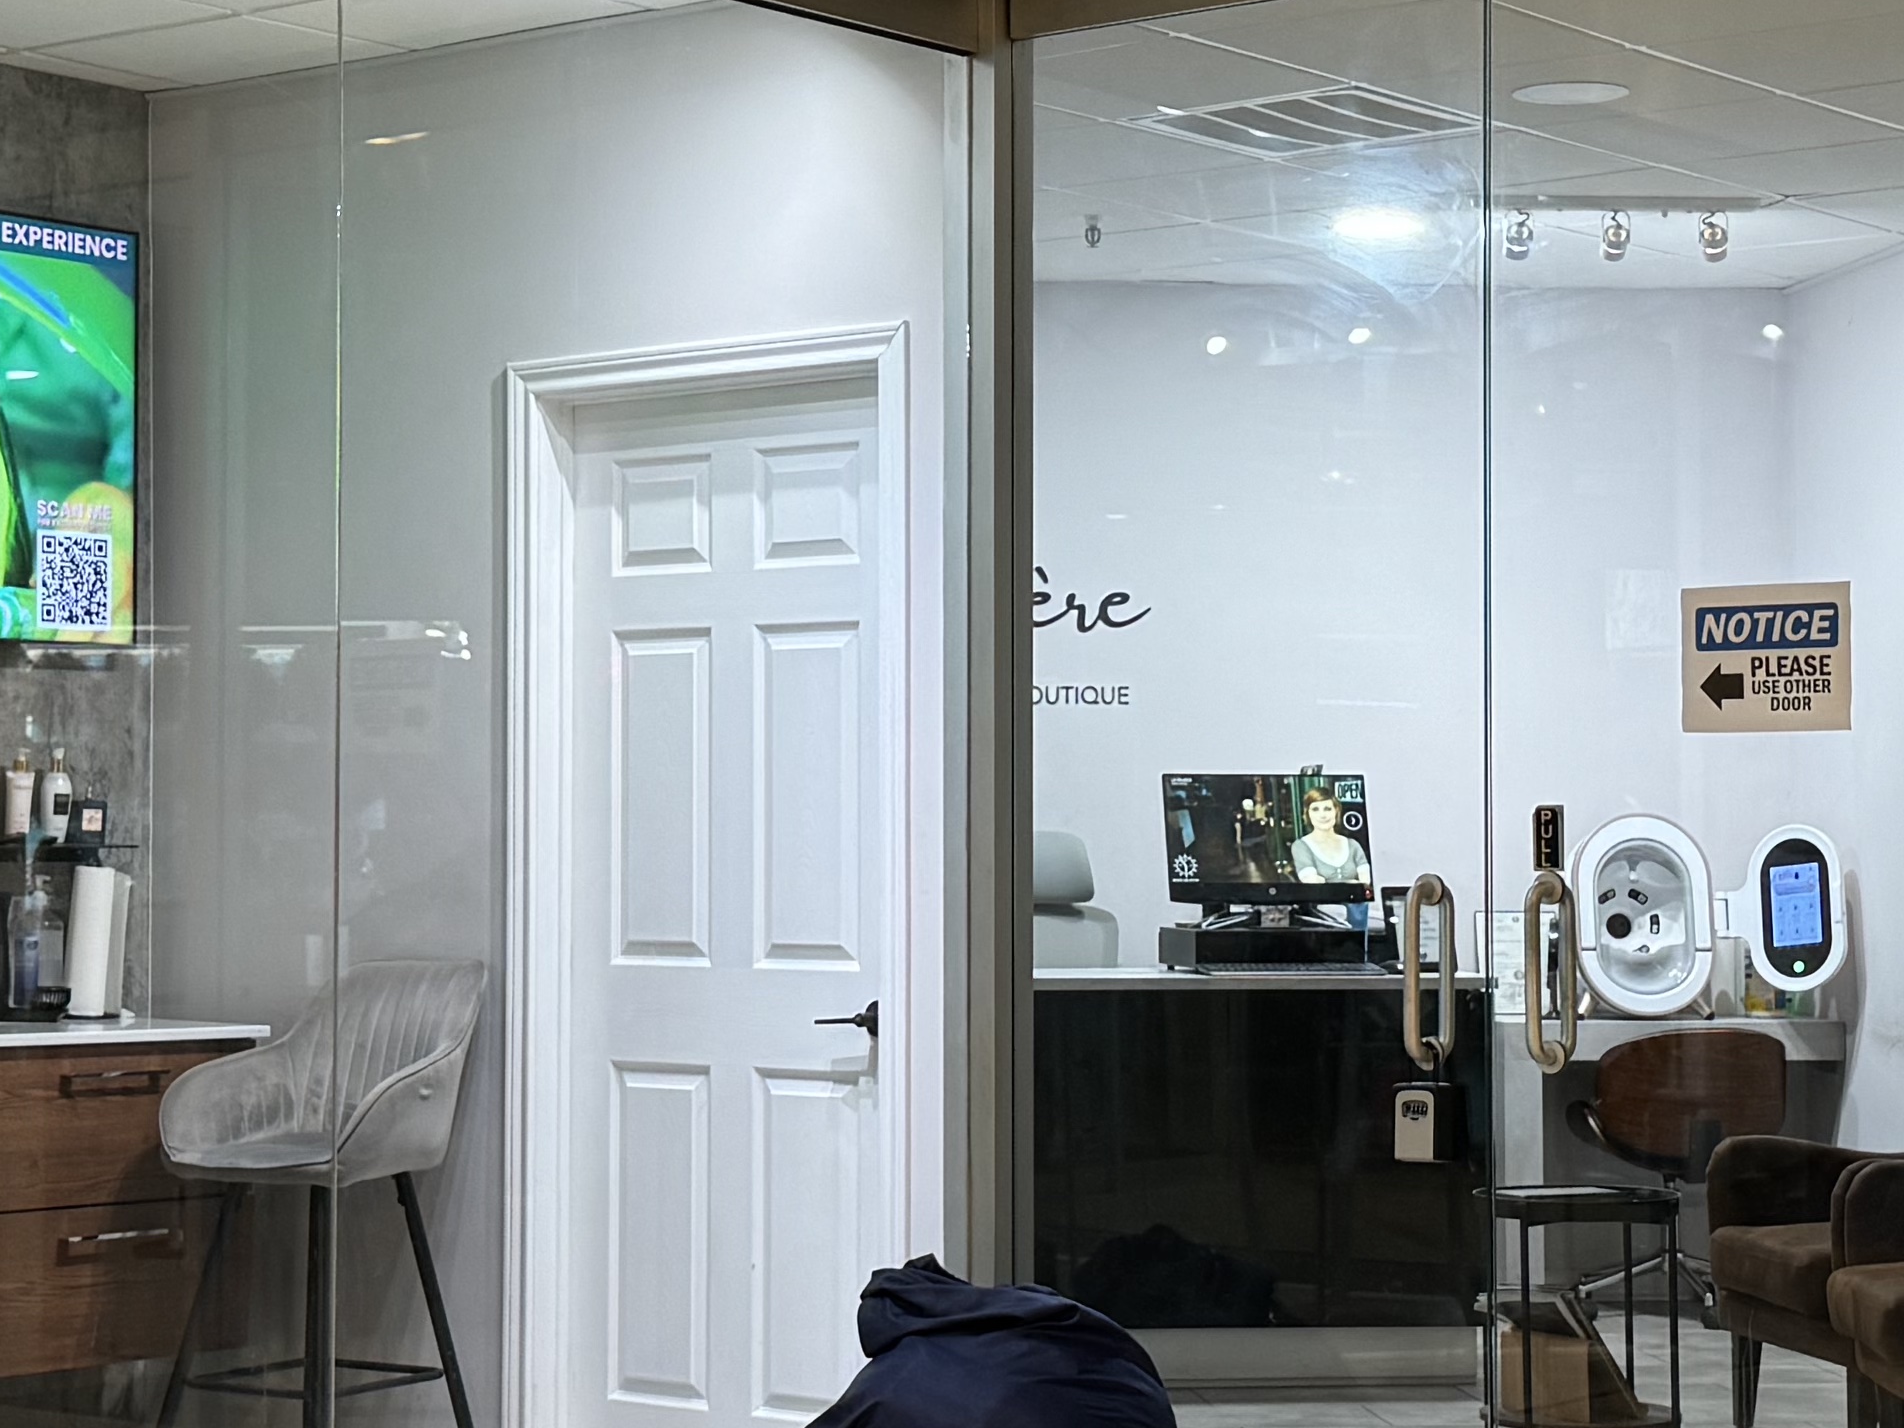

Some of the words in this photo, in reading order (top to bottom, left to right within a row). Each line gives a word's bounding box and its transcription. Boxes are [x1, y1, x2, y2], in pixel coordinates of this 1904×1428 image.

[1, 222, 128, 261] EXPERIENCE
[37, 499, 84, 518] SCAN
[1701, 608, 1835, 645] NOTICE
[1750, 654, 1832, 678] PLEASE
[1032, 685, 1130, 705] OUTIQUE
[1751, 679, 1780, 695] USE
[1783, 678, 1831, 694] OTHER
[1770, 696, 1812, 712] DOOR
[1540, 810, 1553, 867] PULL
